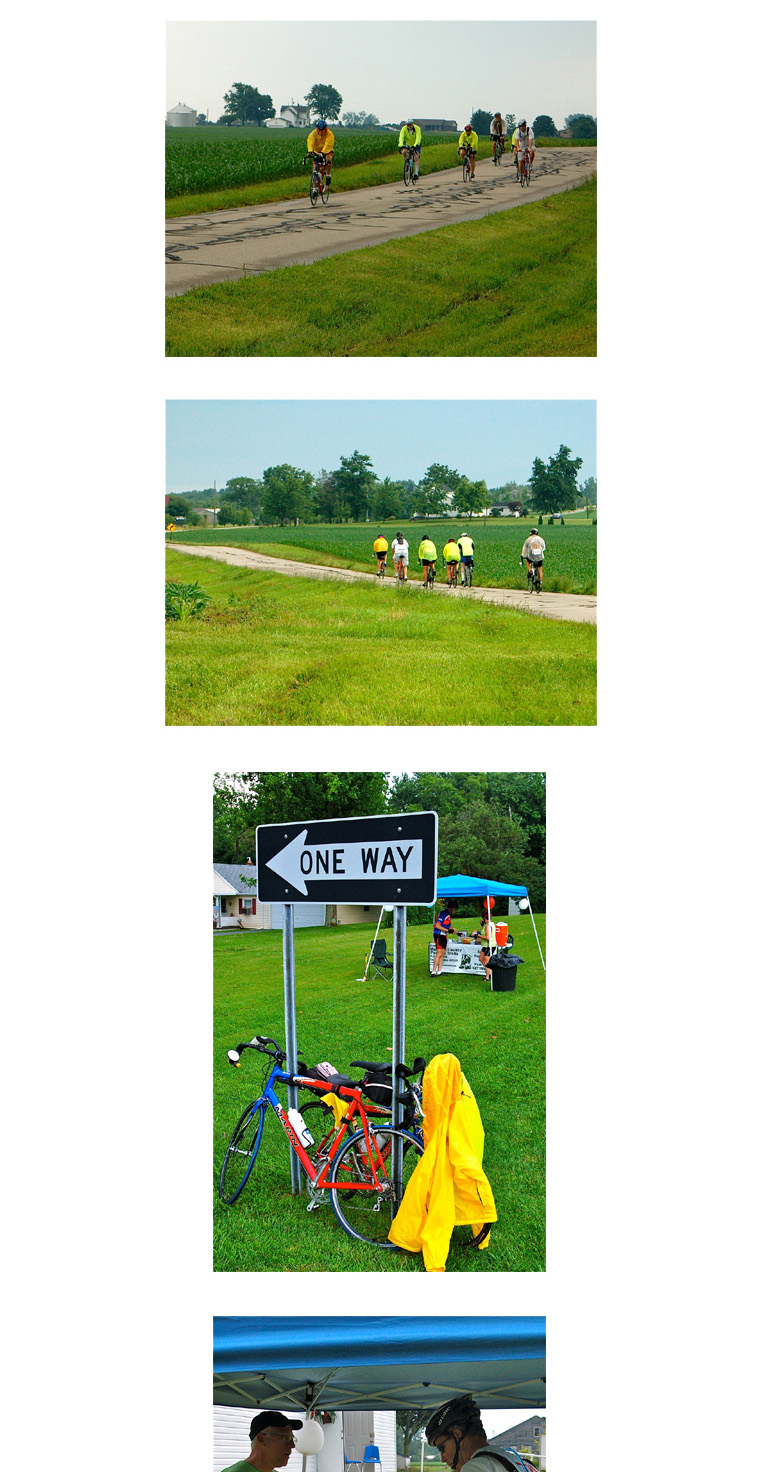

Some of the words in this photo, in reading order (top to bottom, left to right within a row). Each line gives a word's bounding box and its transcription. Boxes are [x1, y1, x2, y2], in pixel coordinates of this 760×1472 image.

[300, 849, 345, 875] ONE
[361, 846, 414, 873] WAY
[274, 1105, 299, 1147] MARIN
